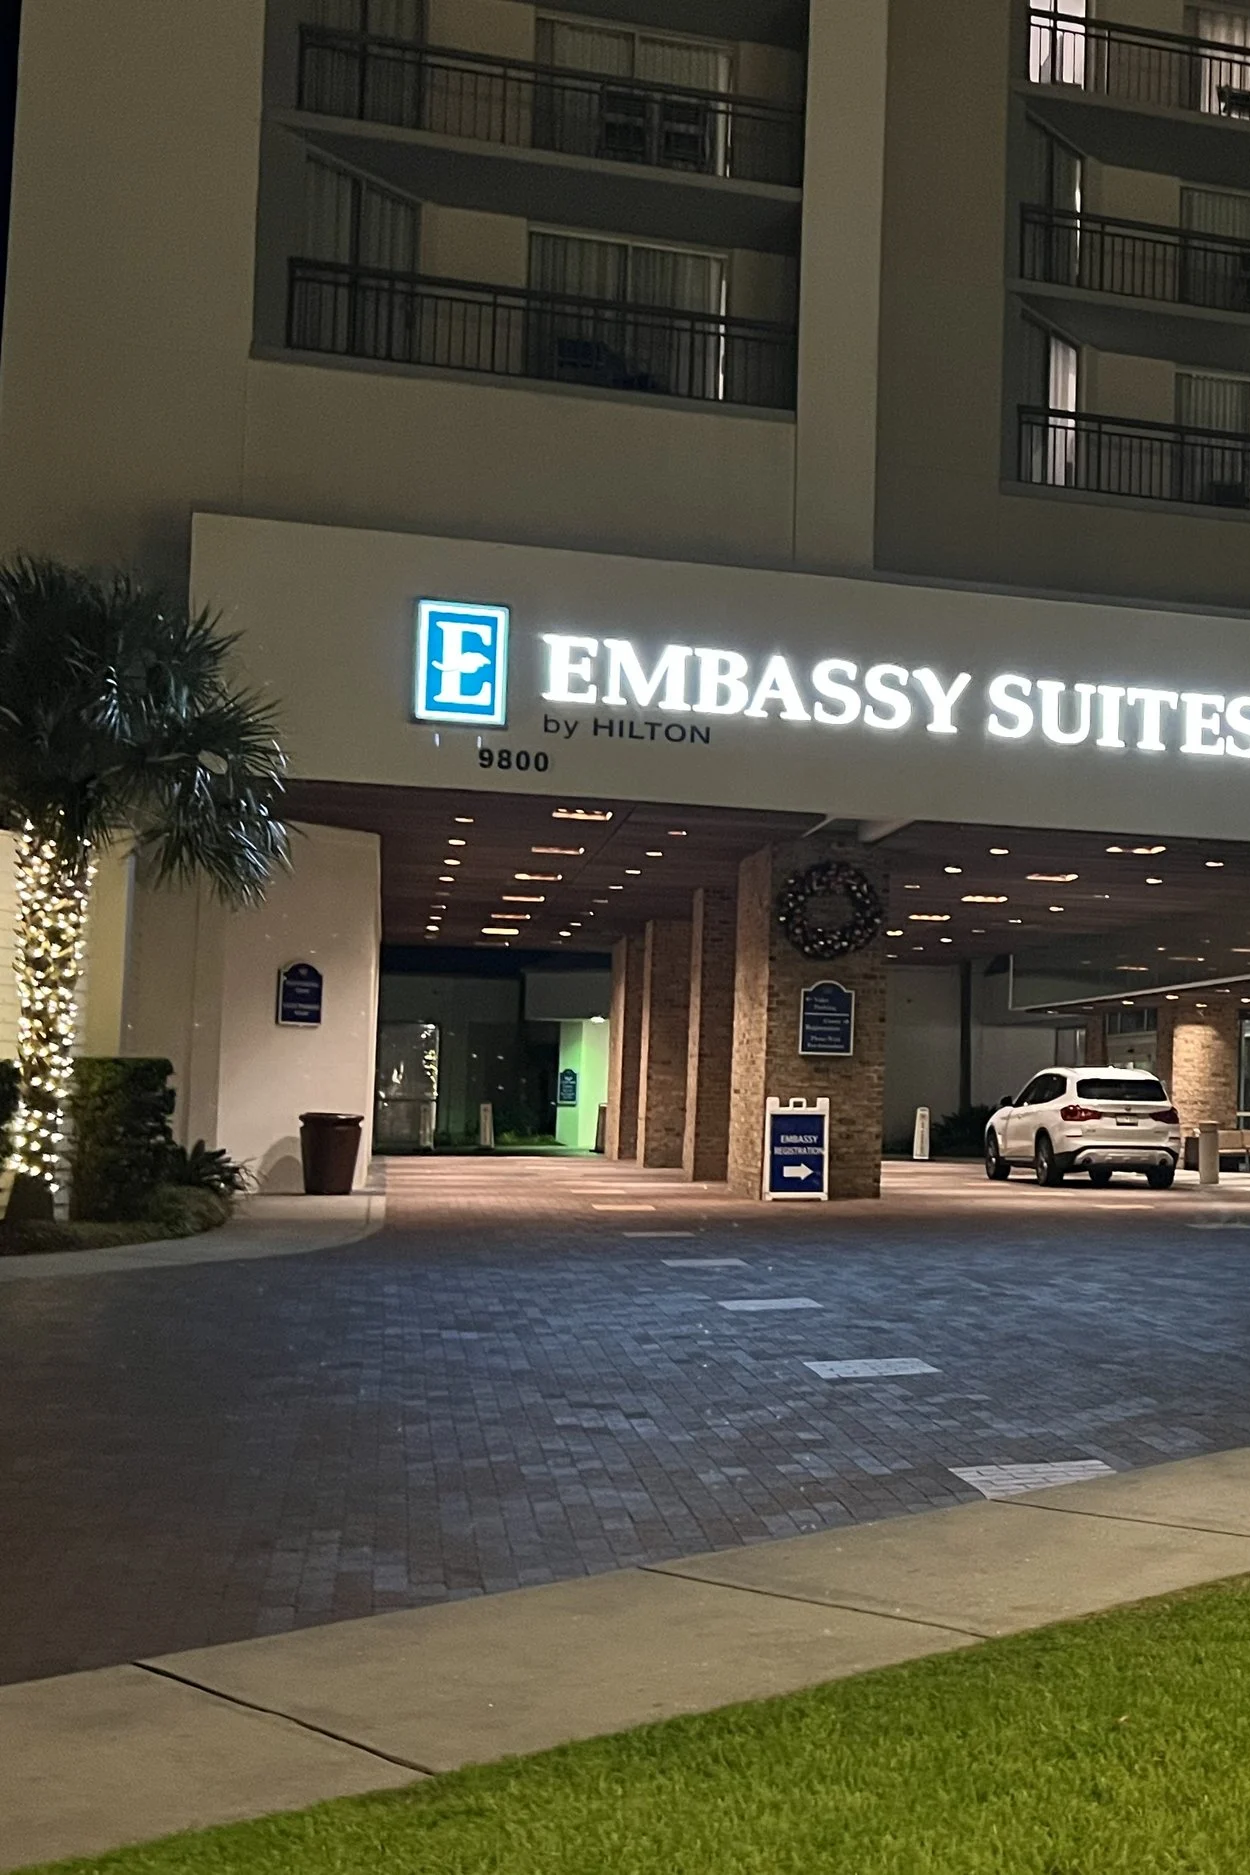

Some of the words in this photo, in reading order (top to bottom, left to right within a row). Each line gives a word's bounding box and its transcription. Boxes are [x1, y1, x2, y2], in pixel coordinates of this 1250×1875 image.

[432, 620, 492, 706] E
[540, 632, 972, 735] EMBASSY
[543, 714, 579, 738] by
[593, 716, 711, 744] HILTON
[478, 748, 550, 772] 9800
[773, 1146, 824, 1155] REGISTRATION
[780, 1134, 819, 1144] EMBASSY
